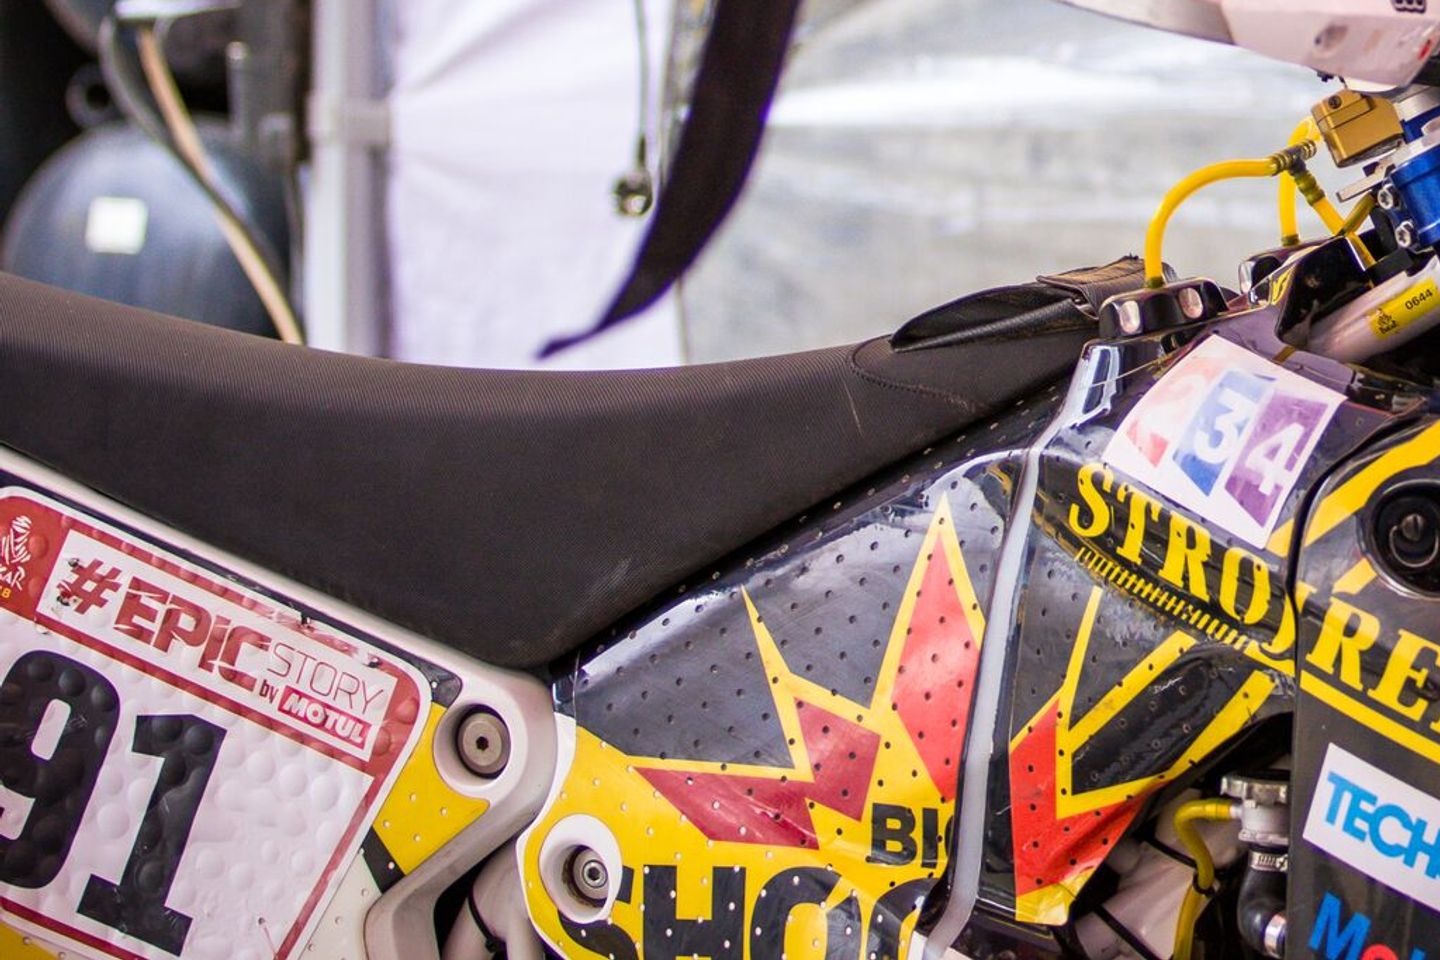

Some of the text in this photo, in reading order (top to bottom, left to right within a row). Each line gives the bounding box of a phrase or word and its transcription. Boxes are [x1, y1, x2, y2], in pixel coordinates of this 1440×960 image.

[1404, 288, 1434, 310] 0644
[266, 642, 384, 714] STORY
[259, 679, 366, 745] by MOTUL
[0, 649, 228, 957] 91
[870, 802, 956, 869] BI
